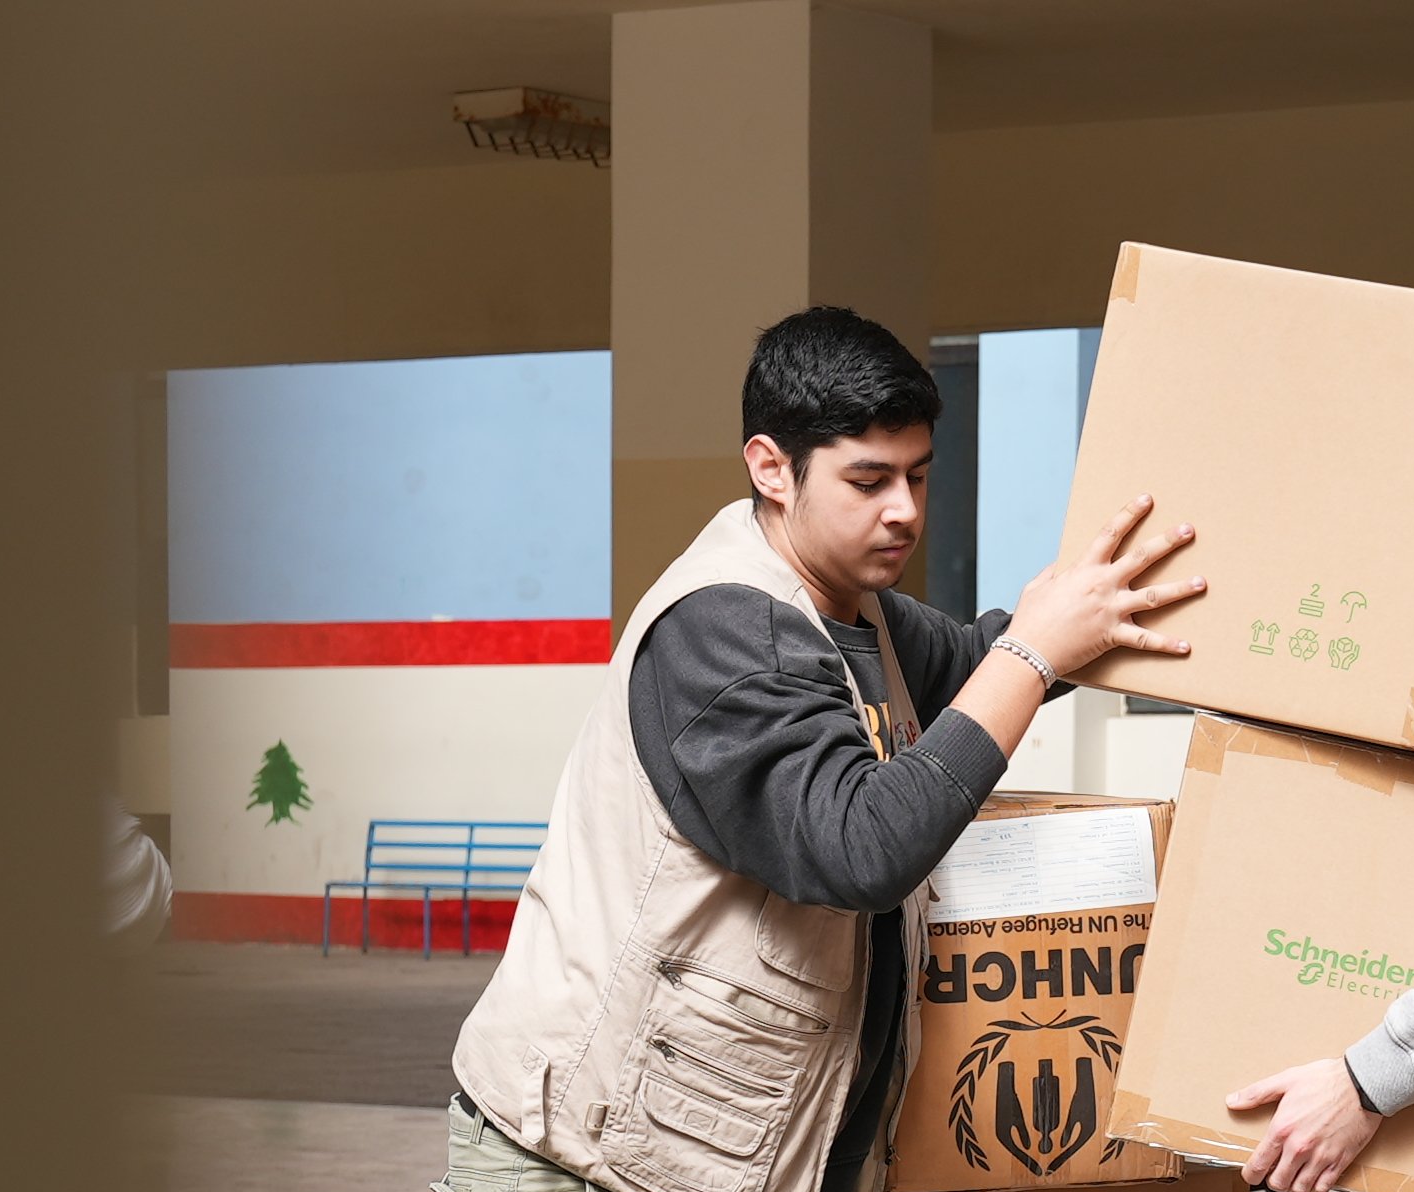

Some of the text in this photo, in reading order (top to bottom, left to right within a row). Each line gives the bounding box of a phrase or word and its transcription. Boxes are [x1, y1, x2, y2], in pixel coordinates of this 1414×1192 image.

[1311, 583, 1321, 597] 2
[1002, 914, 1082, 937] Refugee
[1089, 915, 1118, 934] UN
[1327, 972, 1401, 1000] Electri
